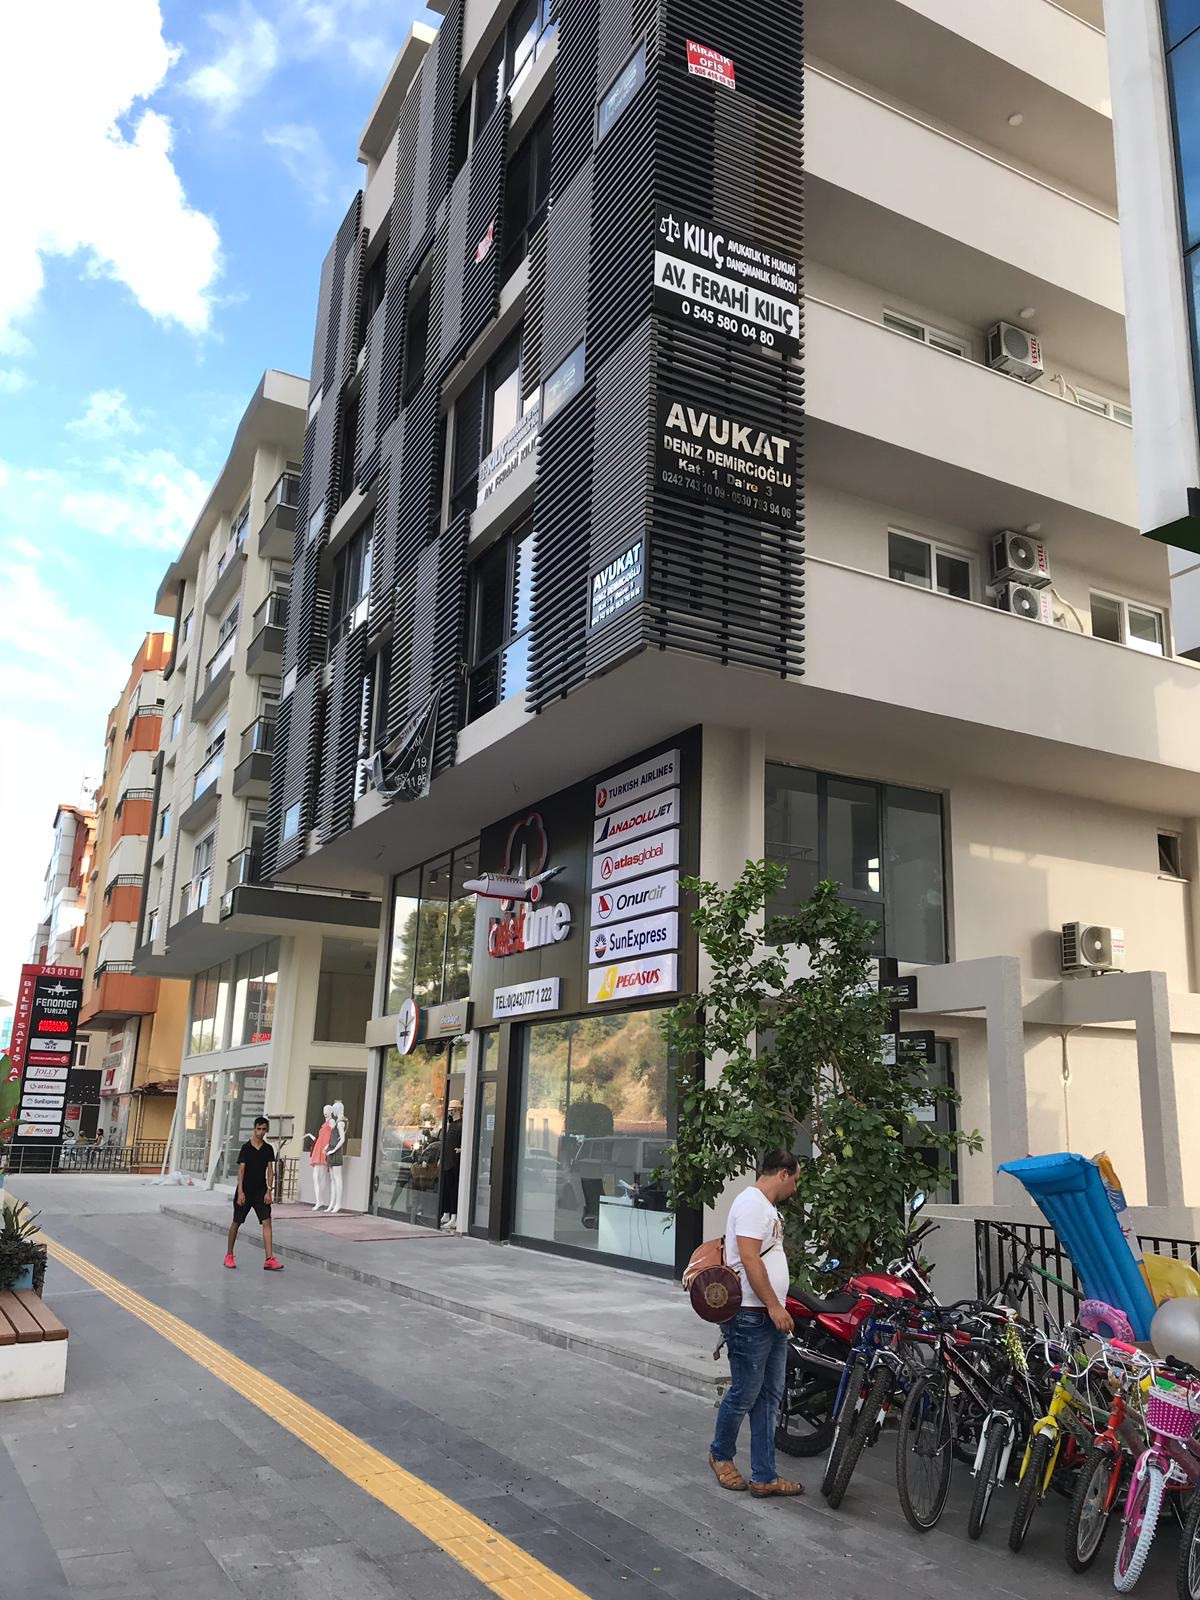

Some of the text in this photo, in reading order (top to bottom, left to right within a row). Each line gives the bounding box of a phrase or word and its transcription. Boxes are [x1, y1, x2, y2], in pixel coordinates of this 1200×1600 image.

[700, 57, 724, 73] OFİS
[684, 222, 796, 277] KILIÇ AVUKATLIK VE HUKUKİ
[726, 256, 797, 294] DANIŞMANLIK BÜROSU
[662, 262, 794, 335] AV. FERAHİ KILIÇ
[682, 301, 774, 346] 0 545 580 04 80
[665, 402, 790, 464] AVUKAT
[662, 470, 683, 486] 0242
[685, 477, 700, 492] 743
[703, 482, 712, 495] 10
[769, 503, 780, 516] 94
[781, 507, 791, 519] 06
[712, 469, 718, 480] 1
[765, 485, 773, 497] 3
[593, 542, 641, 593] AVUKAT
[609, 762, 673, 799] TURKISH AIRLINES
[609, 802, 673, 836] ANADOLUJET
[614, 843, 663, 870] atlasglobal
[617, 885, 666, 910] Onurair
[610, 927, 666, 951] SunExpress
[540, 987, 552, 1003] 222
[616, 968, 660, 989] PEGASUS
[36, 998, 78, 1009] FENOMEN
